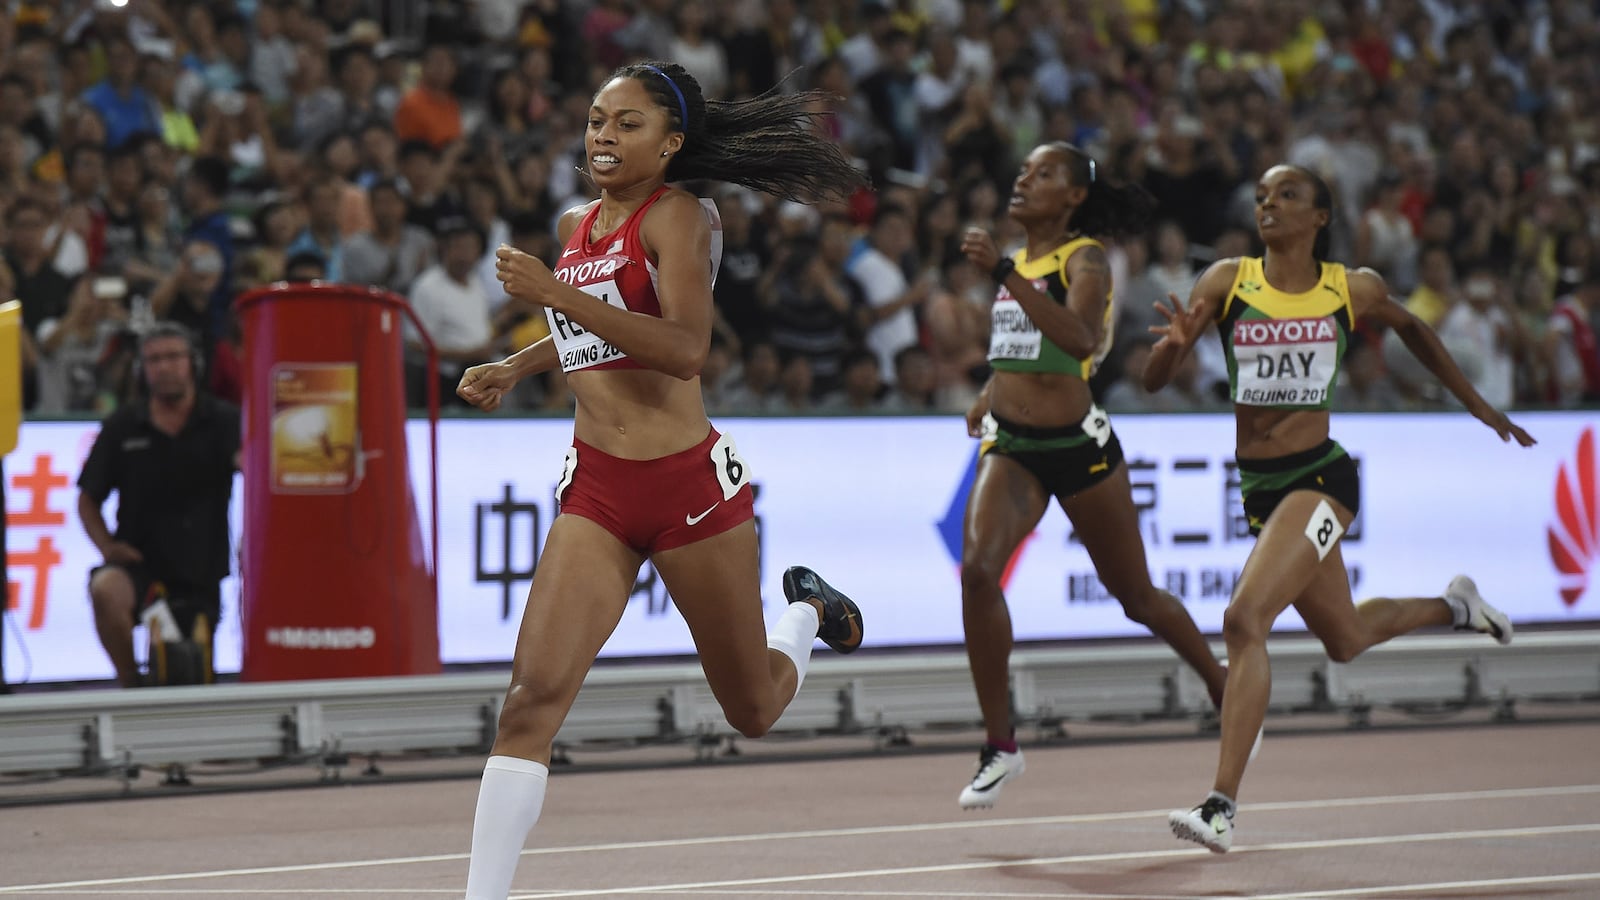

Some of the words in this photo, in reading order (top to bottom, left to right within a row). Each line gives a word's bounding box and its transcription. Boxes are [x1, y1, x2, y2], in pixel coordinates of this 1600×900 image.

[554, 259, 617, 286] OYOTA
[1238, 320, 1334, 343] TOYOTA
[562, 344, 598, 369] EIJING
[602, 342, 620, 357] 20
[1256, 351, 1316, 379] DAY
[1242, 387, 1298, 403] BEIJING
[1301, 388, 1327, 403] 201
[724, 446, 743, 486] 6
[1317, 518, 1334, 547] 8
[283, 626, 376, 650] MONDO
